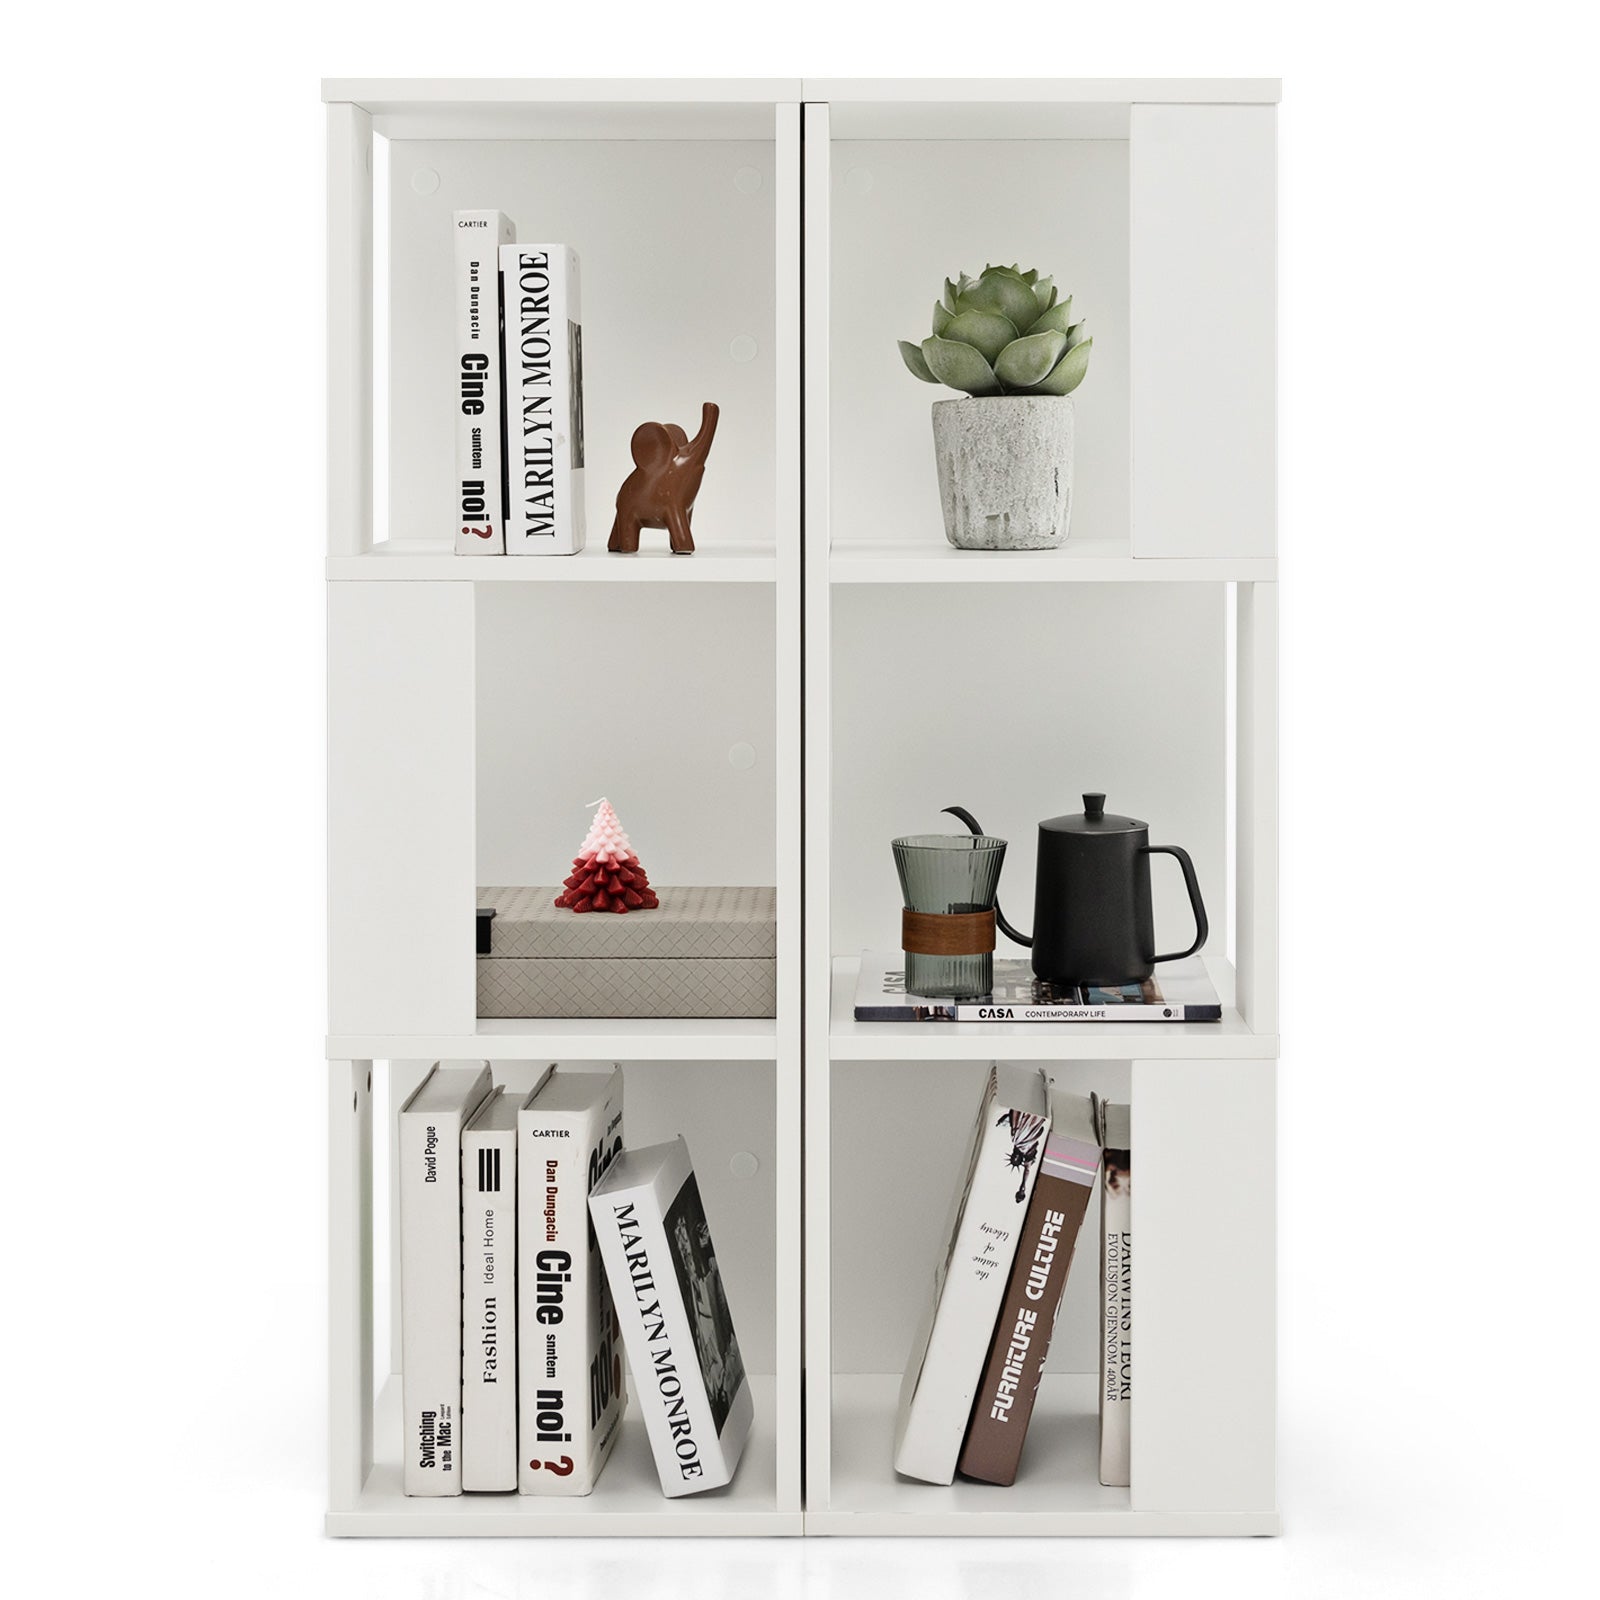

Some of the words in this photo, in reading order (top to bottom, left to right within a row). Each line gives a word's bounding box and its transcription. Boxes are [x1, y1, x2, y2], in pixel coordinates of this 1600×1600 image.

[458, 220, 488, 228] CARTIER
[470, 261, 480, 282] Dan
[470, 287, 480, 339] Dungaciu
[520, 252, 551, 386] MONROE
[461, 354, 489, 415] Cine
[472, 428, 482, 468] suntem
[523, 396, 554, 537] MARILYN
[978, 1008, 1014, 1019] CASA
[1024, 1010, 1089, 1018] CONTEMPORARY
[1089, 1010, 1106, 1018] LIFE
[425, 1126, 439, 1155] Pogue
[532, 1129, 570, 1138] CARTIER
[424, 1156, 437, 1183] David
[546, 1160, 558, 1182] Dan
[484, 1210, 494, 1247] Home
[544, 1187, 558, 1241] Dungaciu
[978, 1222, 1010, 1242] liberty
[983, 1242, 995, 1255] of
[484, 1253, 494, 1283] Ideal
[971, 1256, 999, 1269] statue
[1025, 1209, 1065, 1299] CULTURE
[1106, 1233, 1119, 1302] EVOLUSJON
[536, 1250, 571, 1324] Cine
[975, 1269, 990, 1281] the
[482, 1298, 497, 1383] Fashion
[614, 1203, 668, 1341] MARILYN
[651, 1348, 703, 1480] MONROE
[1106, 1305, 1119, 1364] GJENNOM
[419, 1411, 437, 1468] Switching
[437, 1422, 452, 1447] Mac
[442, 1450, 452, 1462] the
